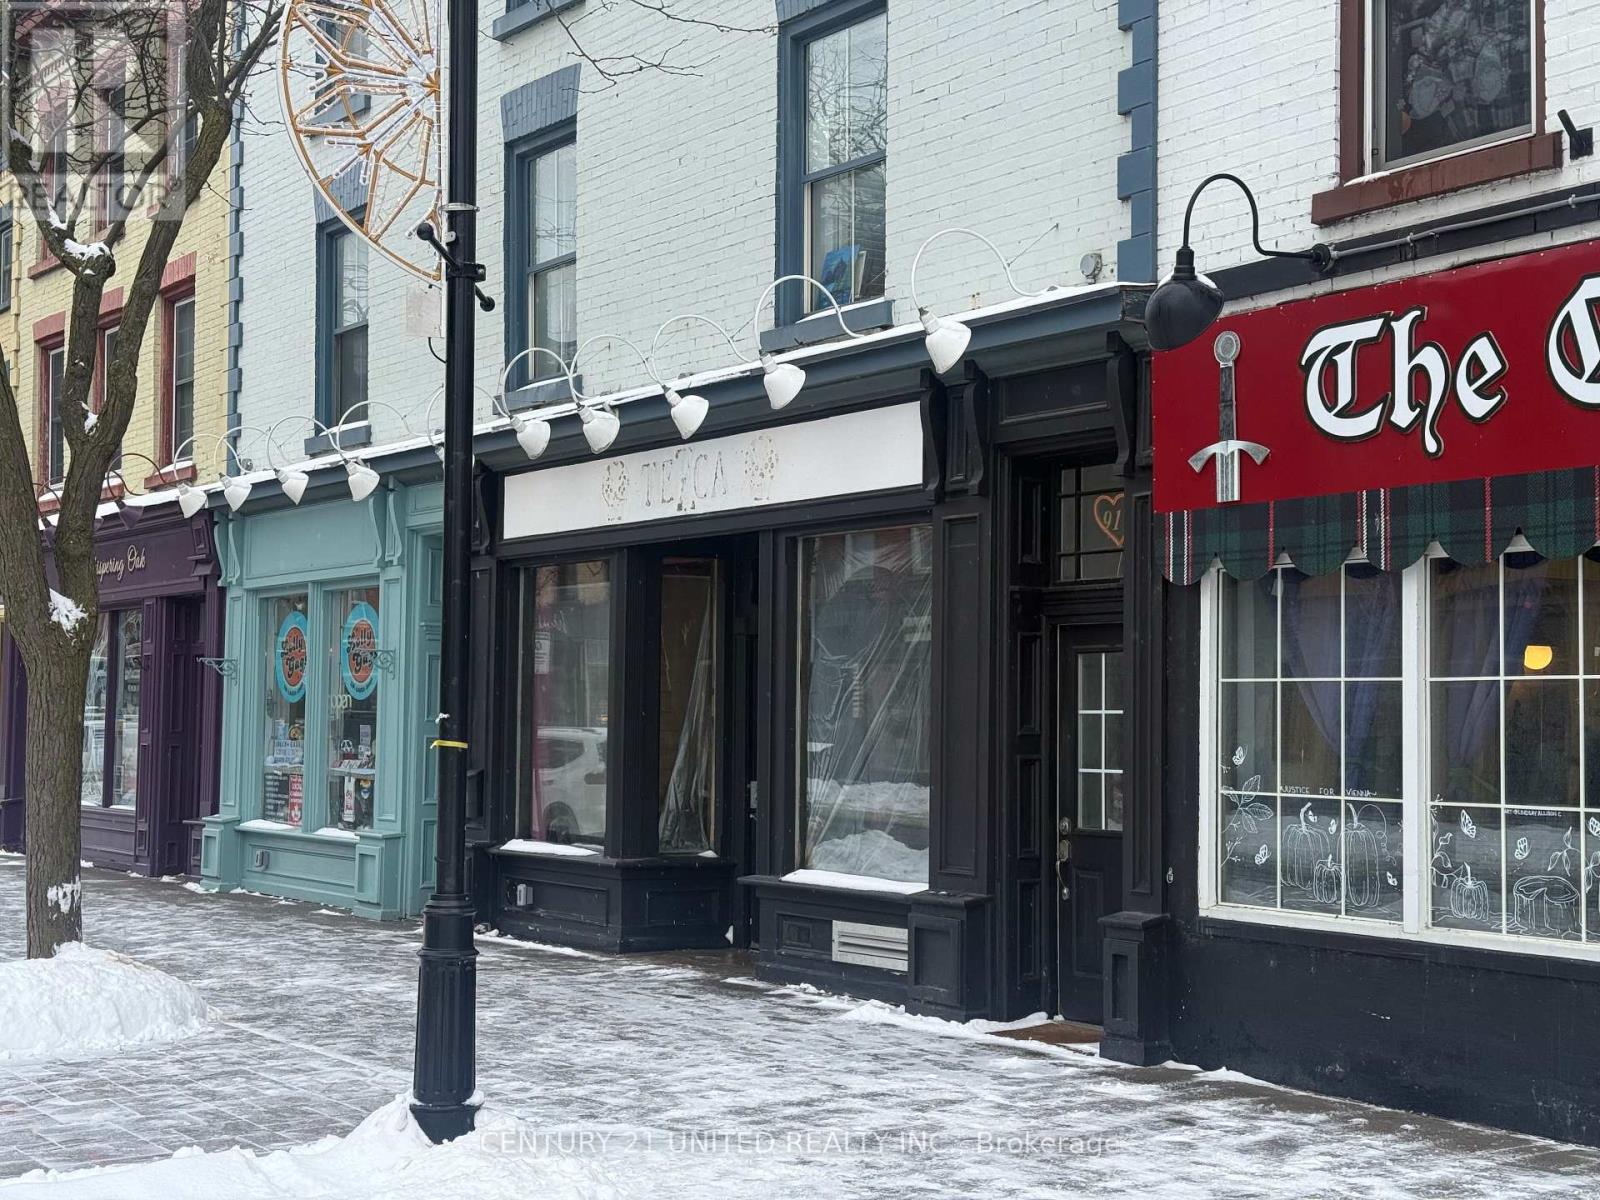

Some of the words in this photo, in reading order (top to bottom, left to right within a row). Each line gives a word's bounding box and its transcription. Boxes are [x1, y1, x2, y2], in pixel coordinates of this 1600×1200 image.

[1300, 306, 1509, 457] The
[94, 556, 124, 582] ispering
[127, 545, 146, 572] Oak
[1319, 787, 1336, 796] FOR
